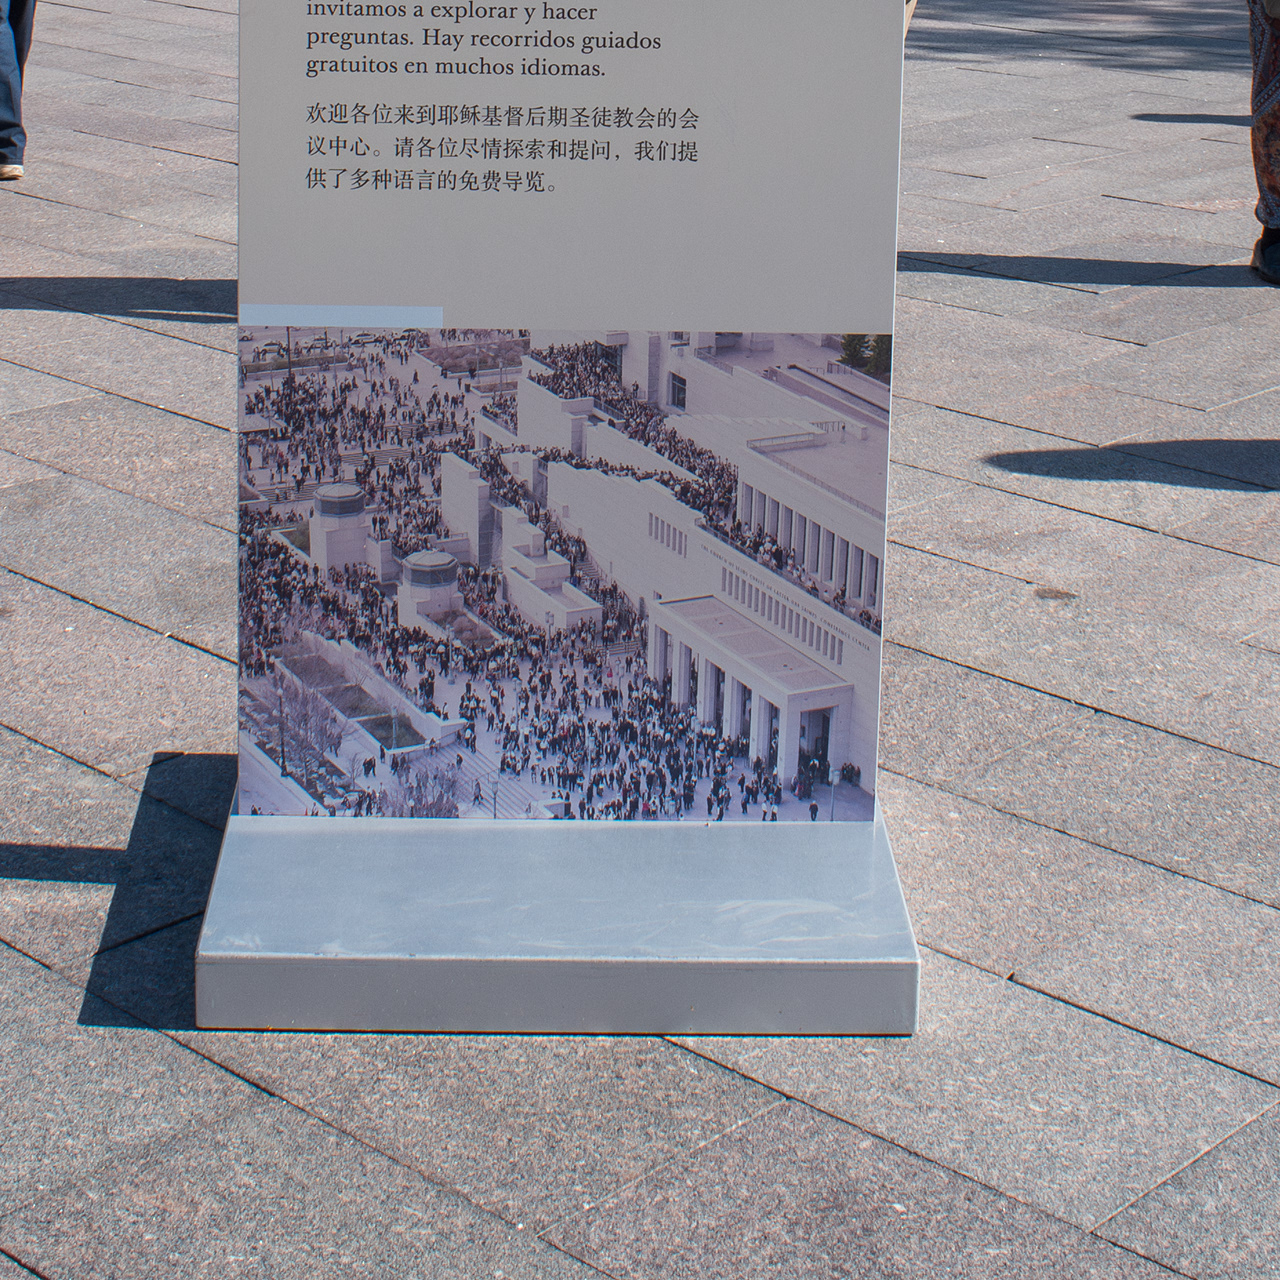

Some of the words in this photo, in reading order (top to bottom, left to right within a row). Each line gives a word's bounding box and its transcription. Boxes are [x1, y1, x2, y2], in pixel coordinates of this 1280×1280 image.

[412, 4, 425, 18] a
[430, 0, 519, 24] explorar
[523, 7, 537, 25] y
[541, 1, 598, 21] hacer
[305, 30, 414, 51] preguntas.
[421, 27, 465, 53] Hay
[470, 29, 575, 49] recorridos
[580, 30, 662, 55] guiados
[305, 54, 398, 79] gratuitos
[404, 61, 429, 74] en
[434, 56, 515, 76] muchos
[520, 57, 606, 77] idiomas.
[305, 101, 700, 130] 欢迎各位来到耶稣基督后期圣徒教会的会
[304, 167, 555, 193] 供了多种语言的免费导览。
